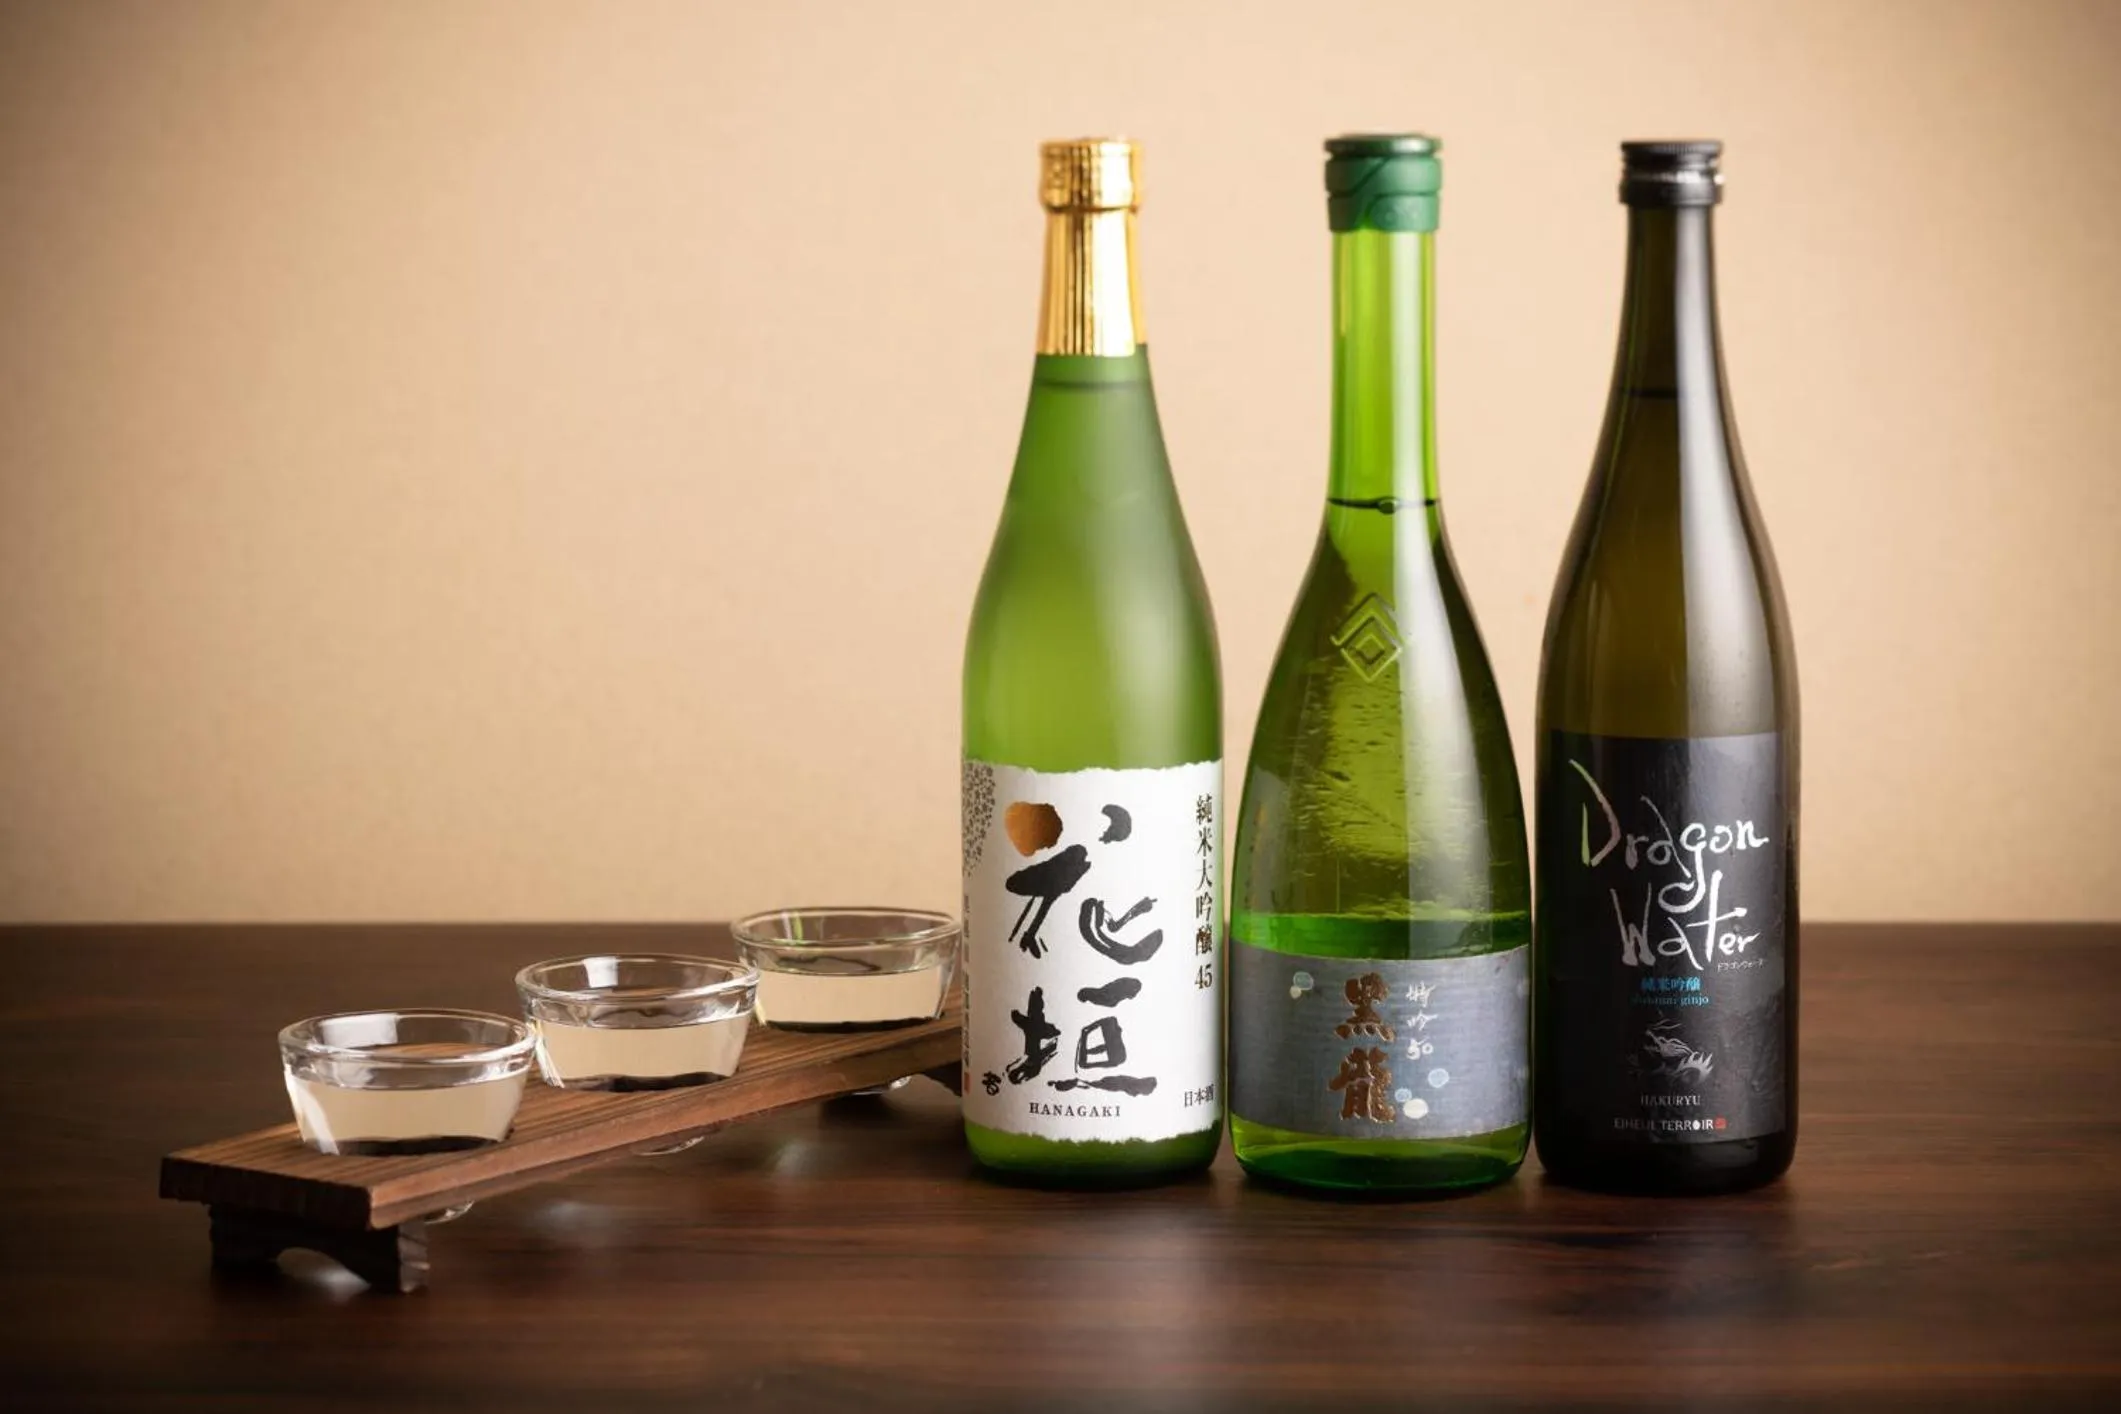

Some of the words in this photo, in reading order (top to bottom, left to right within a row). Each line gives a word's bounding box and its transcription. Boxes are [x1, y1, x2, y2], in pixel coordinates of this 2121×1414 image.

[1569, 759, 1769, 913] Dragon
[1195, 794, 1213, 956] 純米大吟醸
[1610, 870, 1760, 970] Water
[1005, 801, 1163, 1096] 花垣
[1194, 964, 1213, 990] 45
[1184, 1083, 1214, 1108] 日本酒
[1640, 1094, 1701, 1107] HAKURYU
[1029, 1102, 1121, 1117] HANAGAKI
[1661, 1119, 1714, 1131] TERROIR
